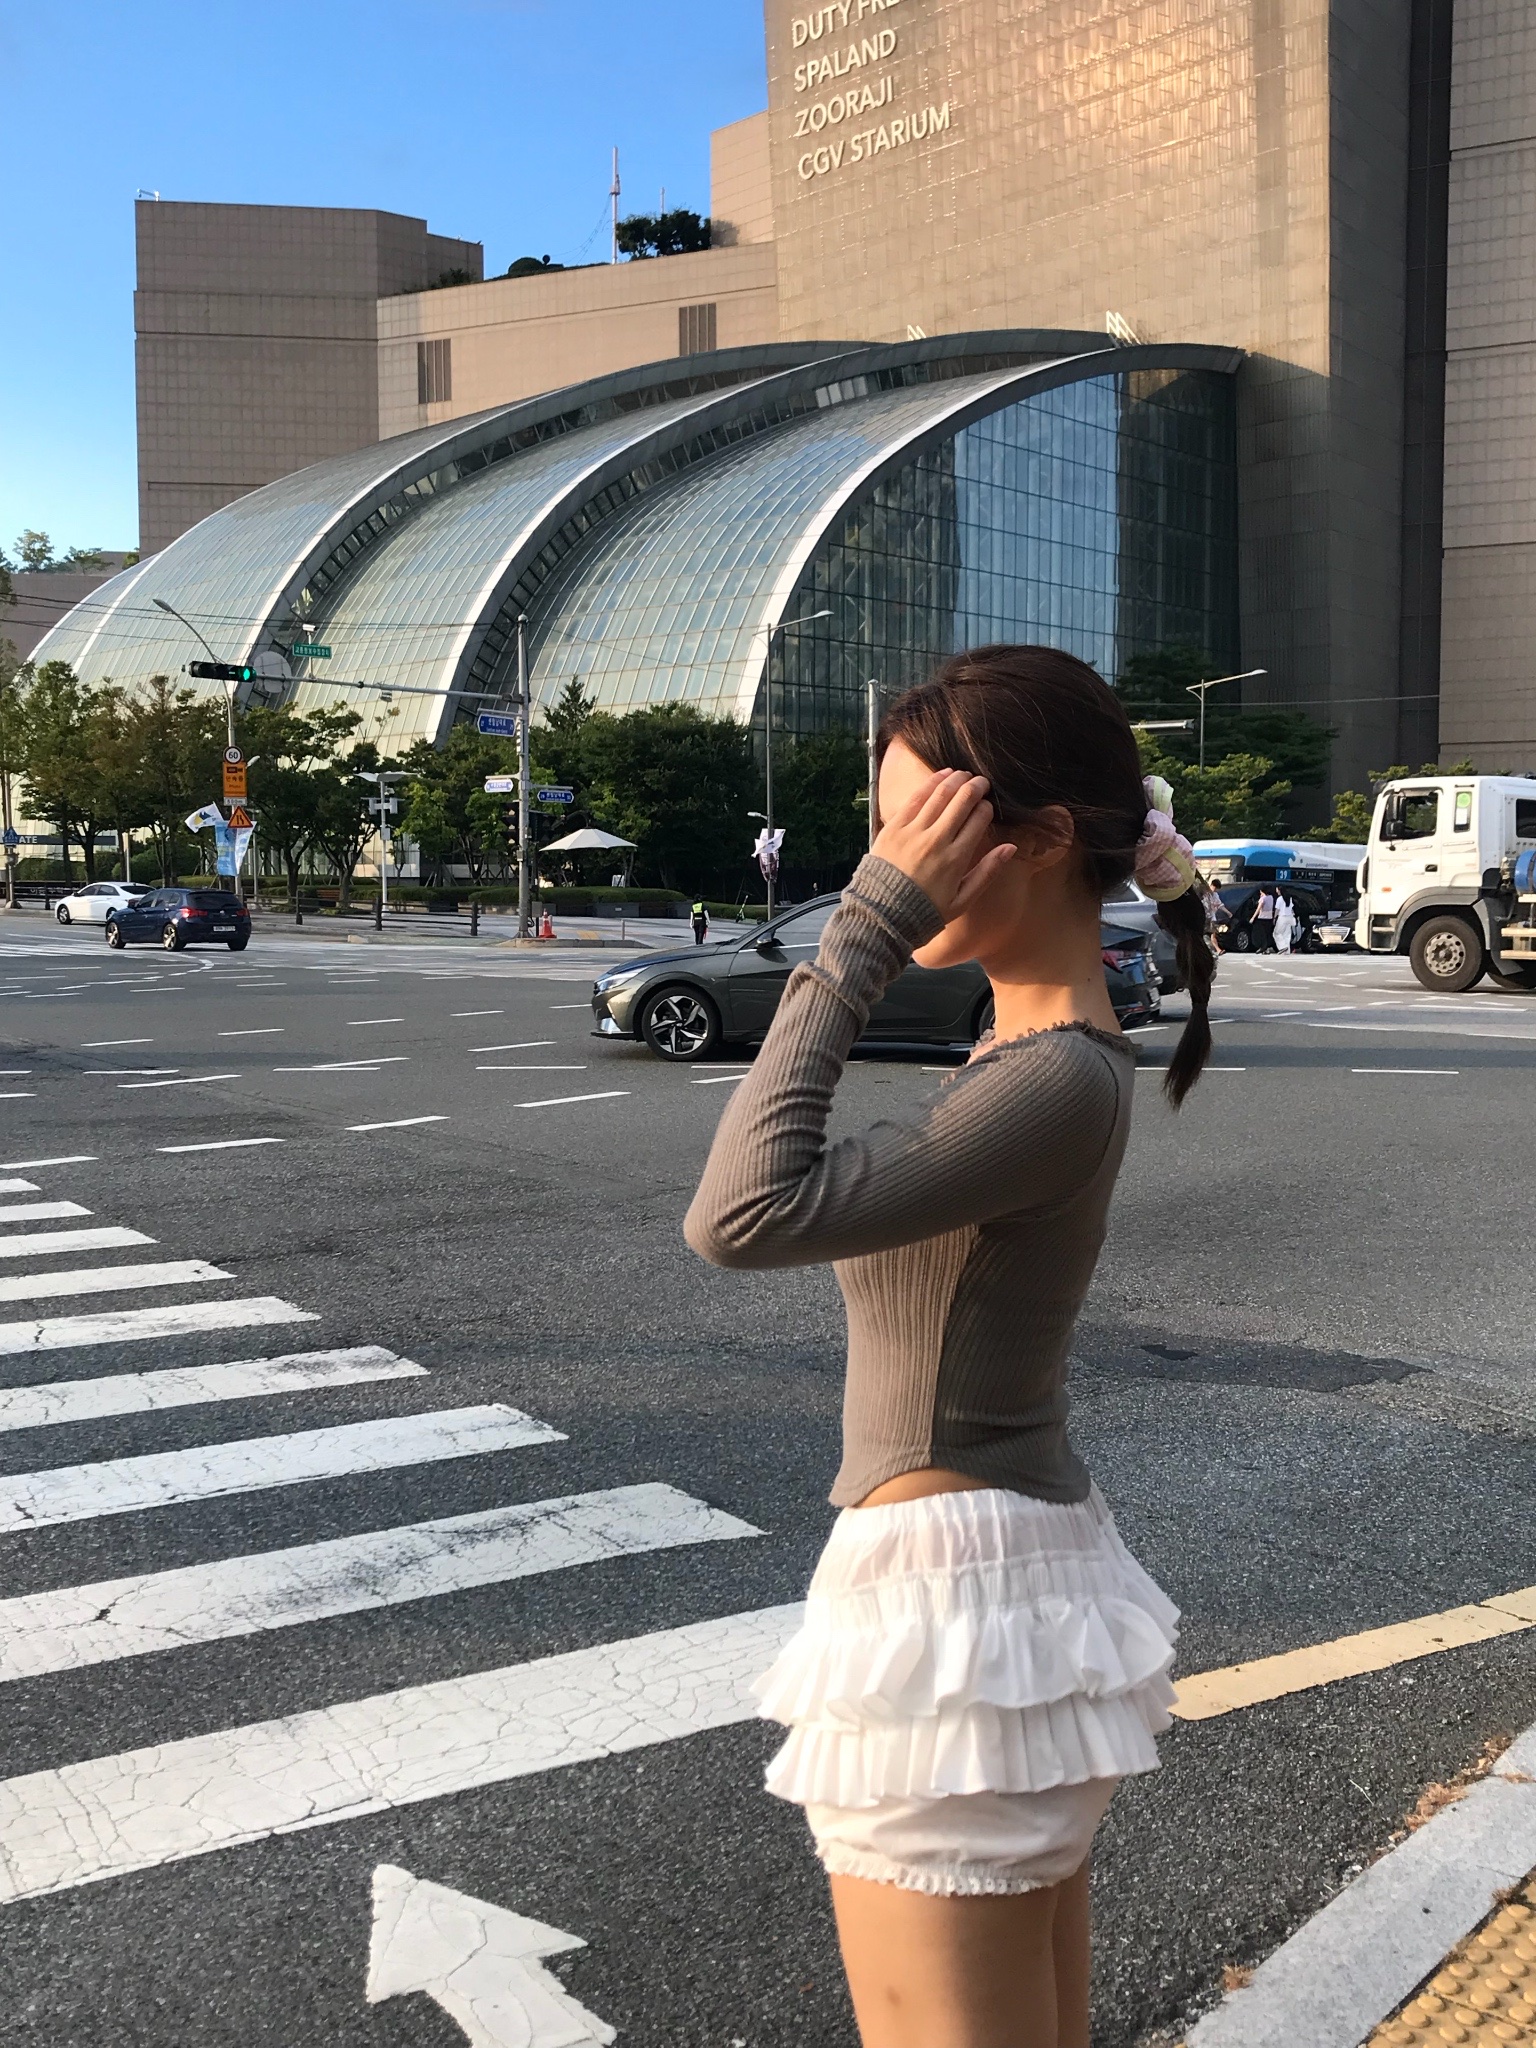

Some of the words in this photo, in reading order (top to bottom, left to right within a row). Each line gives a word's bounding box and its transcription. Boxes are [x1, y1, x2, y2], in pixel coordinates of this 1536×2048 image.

[792, 0, 851, 48] DUTY
[794, 29, 897, 92] SPALAND
[794, 76, 895, 137] ZOORAJI
[798, 140, 846, 180] CGV
[851, 101, 950, 162] STARIUM
[1279, 870, 1288, 879] 39
